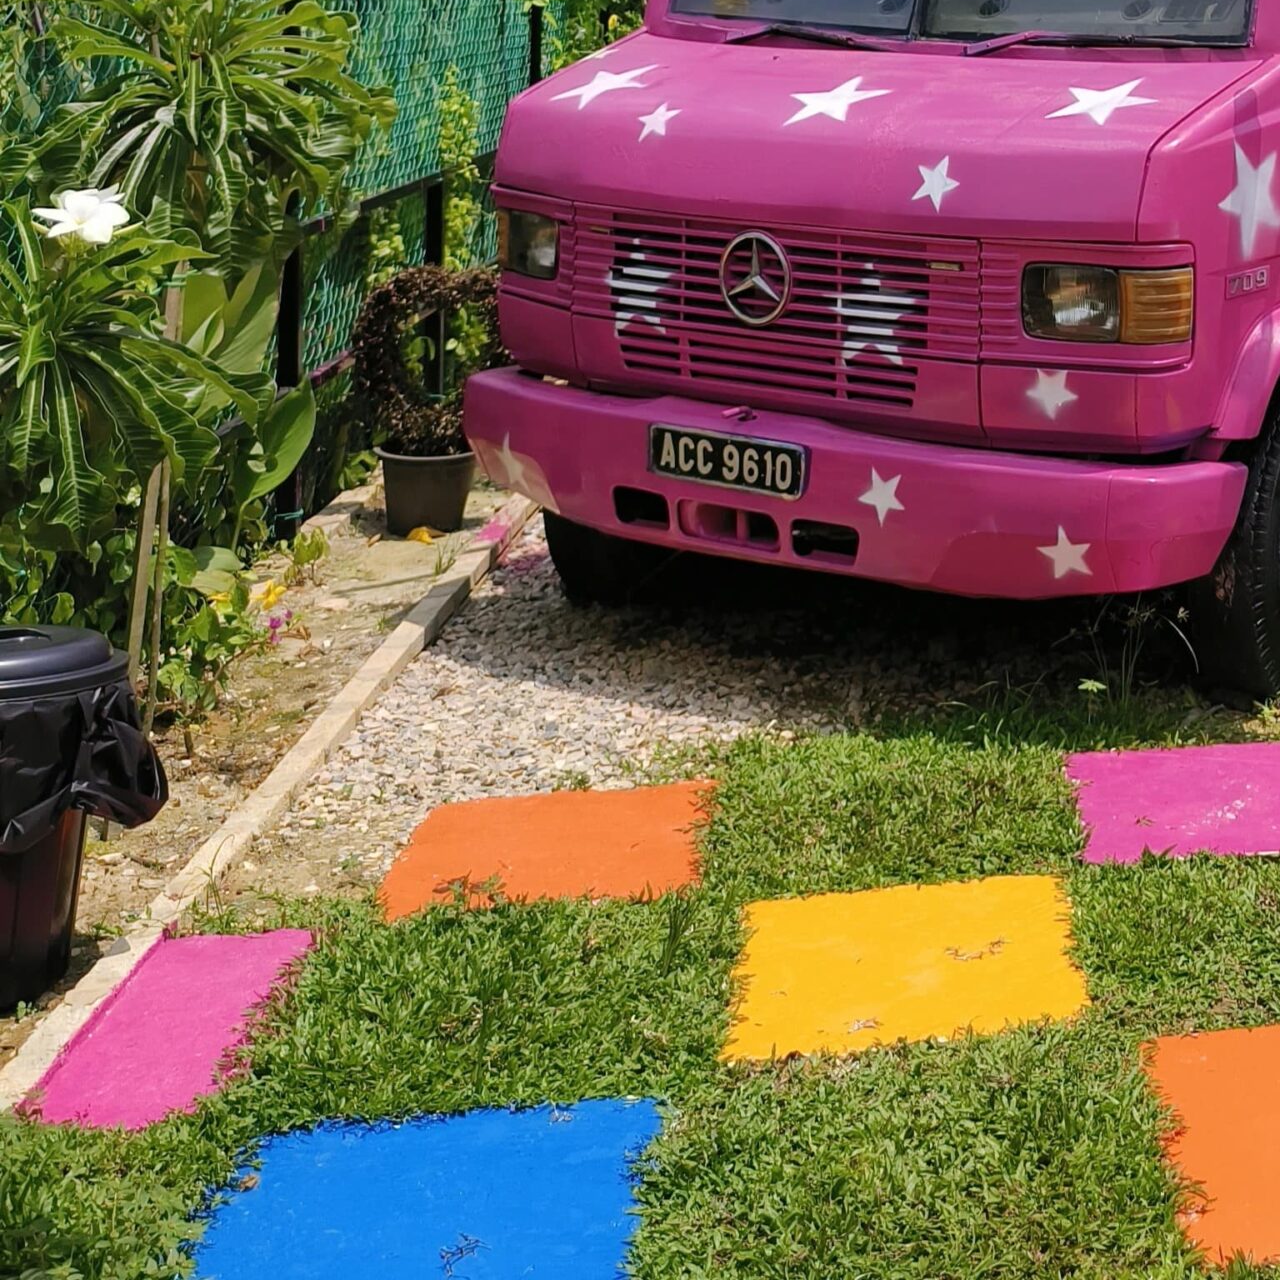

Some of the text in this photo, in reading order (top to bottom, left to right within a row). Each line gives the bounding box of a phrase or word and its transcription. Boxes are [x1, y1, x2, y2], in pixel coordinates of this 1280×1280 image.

[1229, 268, 1267, 295] 709
[660, 431, 793, 490] ACC 9610
